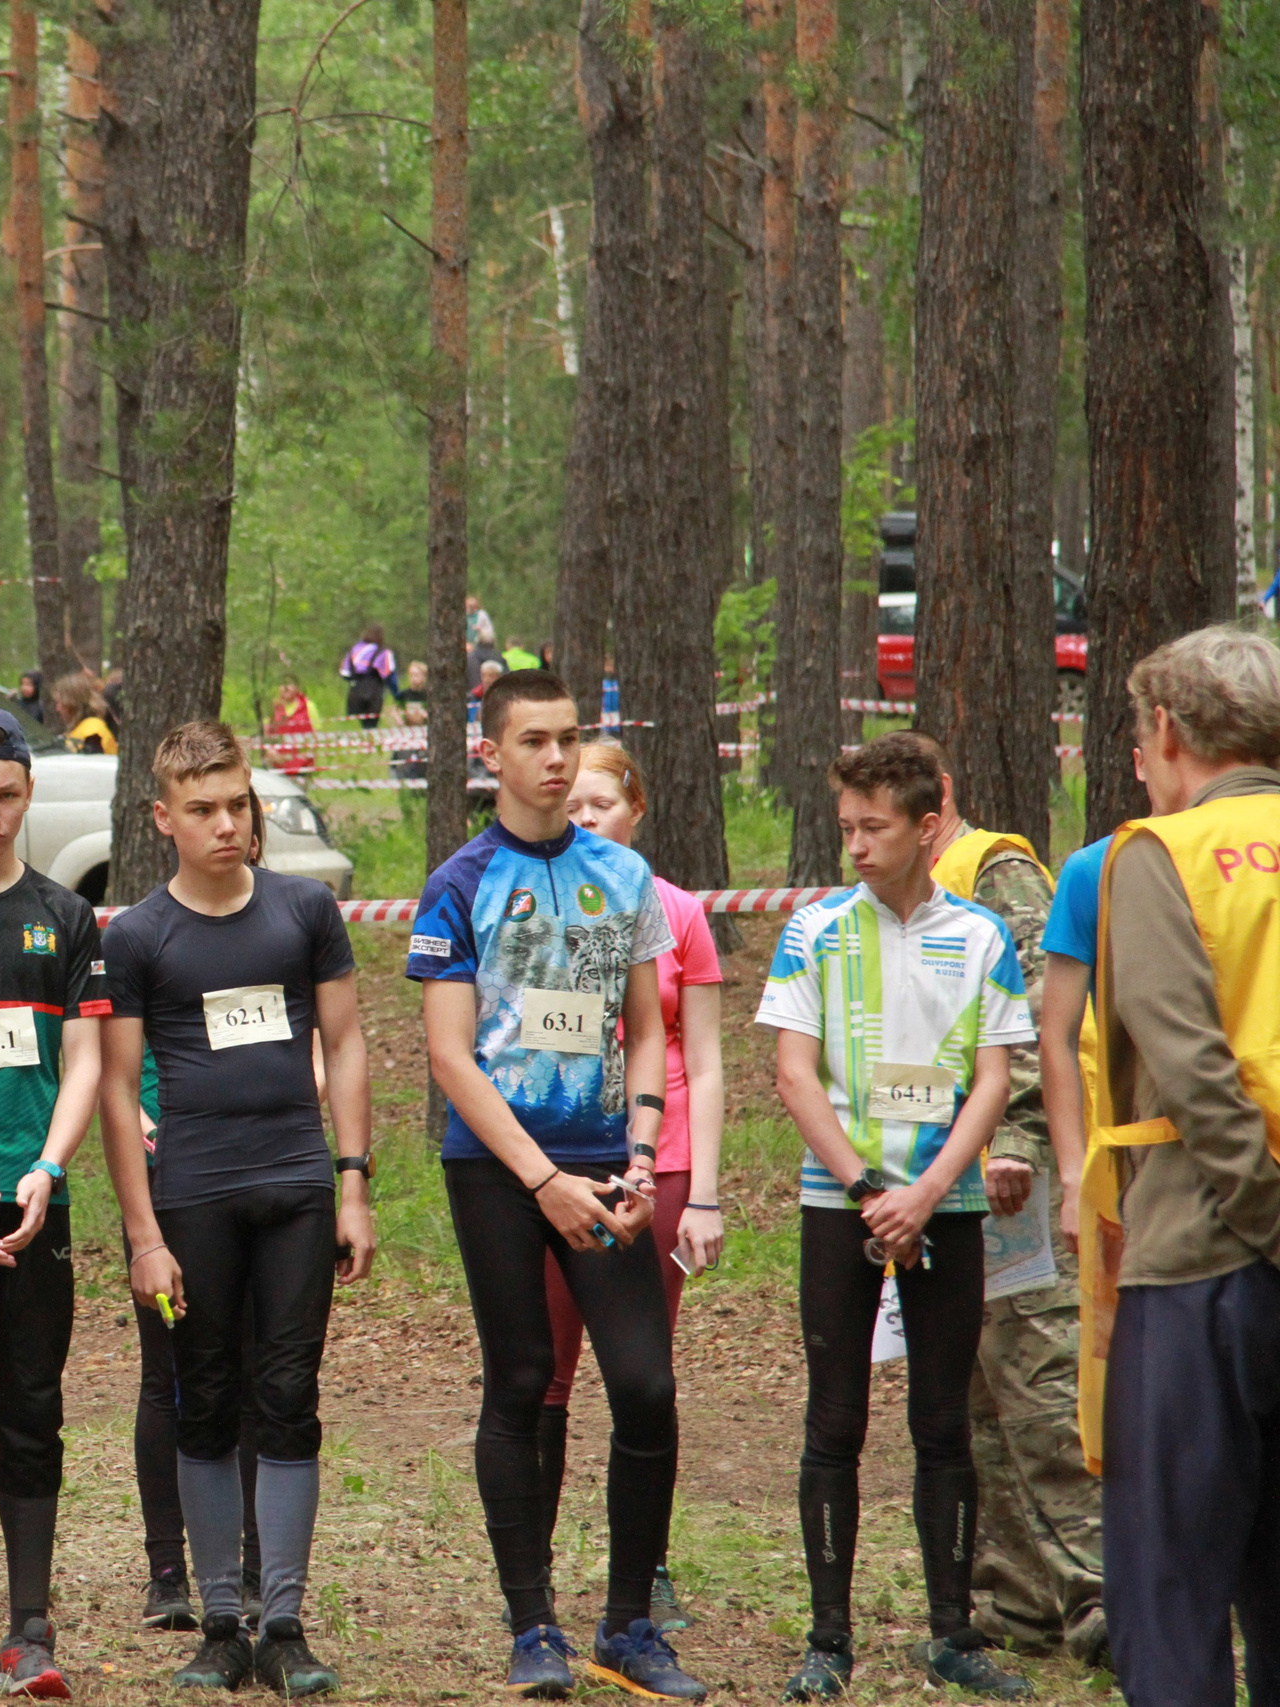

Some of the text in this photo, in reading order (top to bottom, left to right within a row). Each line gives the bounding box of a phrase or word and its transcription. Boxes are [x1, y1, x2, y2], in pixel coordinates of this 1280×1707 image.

[225, 1005, 267, 1027] 62.1
[542, 1011, 584, 1033] 63.1
[890, 1082, 933, 1104] 64.1
